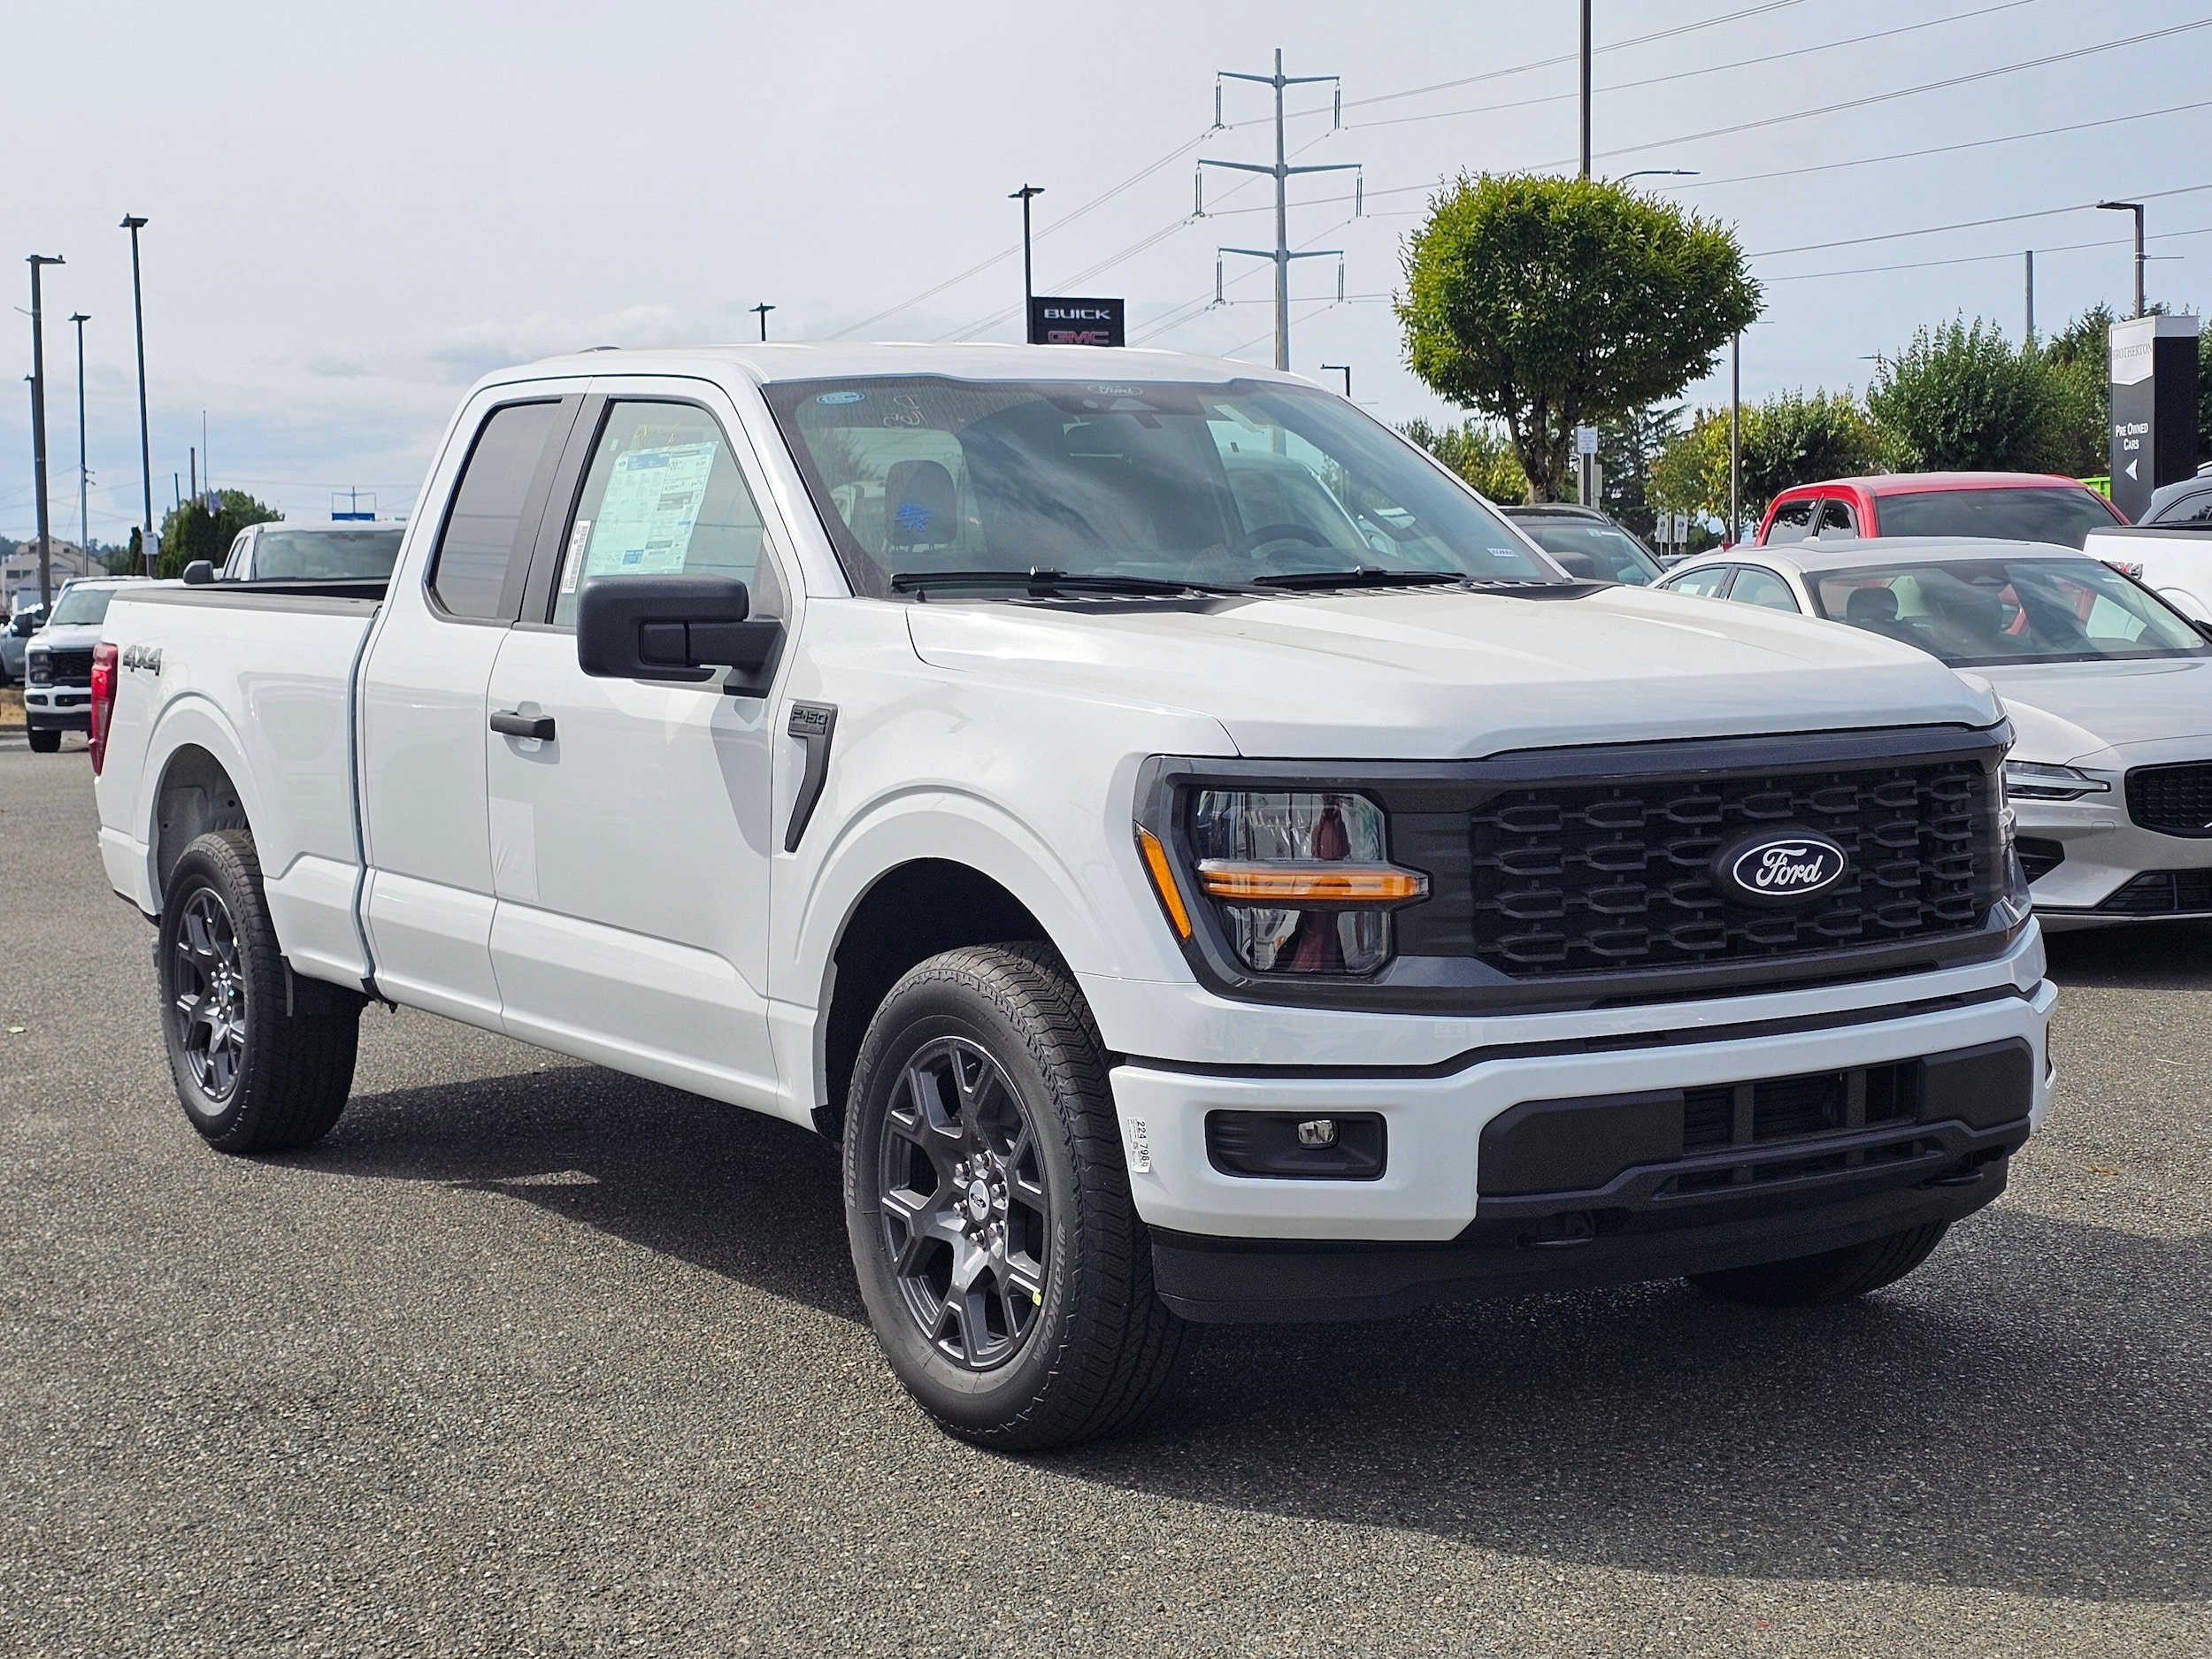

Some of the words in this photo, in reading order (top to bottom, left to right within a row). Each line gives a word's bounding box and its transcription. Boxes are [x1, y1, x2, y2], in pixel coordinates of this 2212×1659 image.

[1044, 309, 1111, 319] BUICK
[1048, 330, 1110, 344] GMC
[1755, 848, 1824, 887] Ford
[1137, 1121, 1147, 1139] 224
